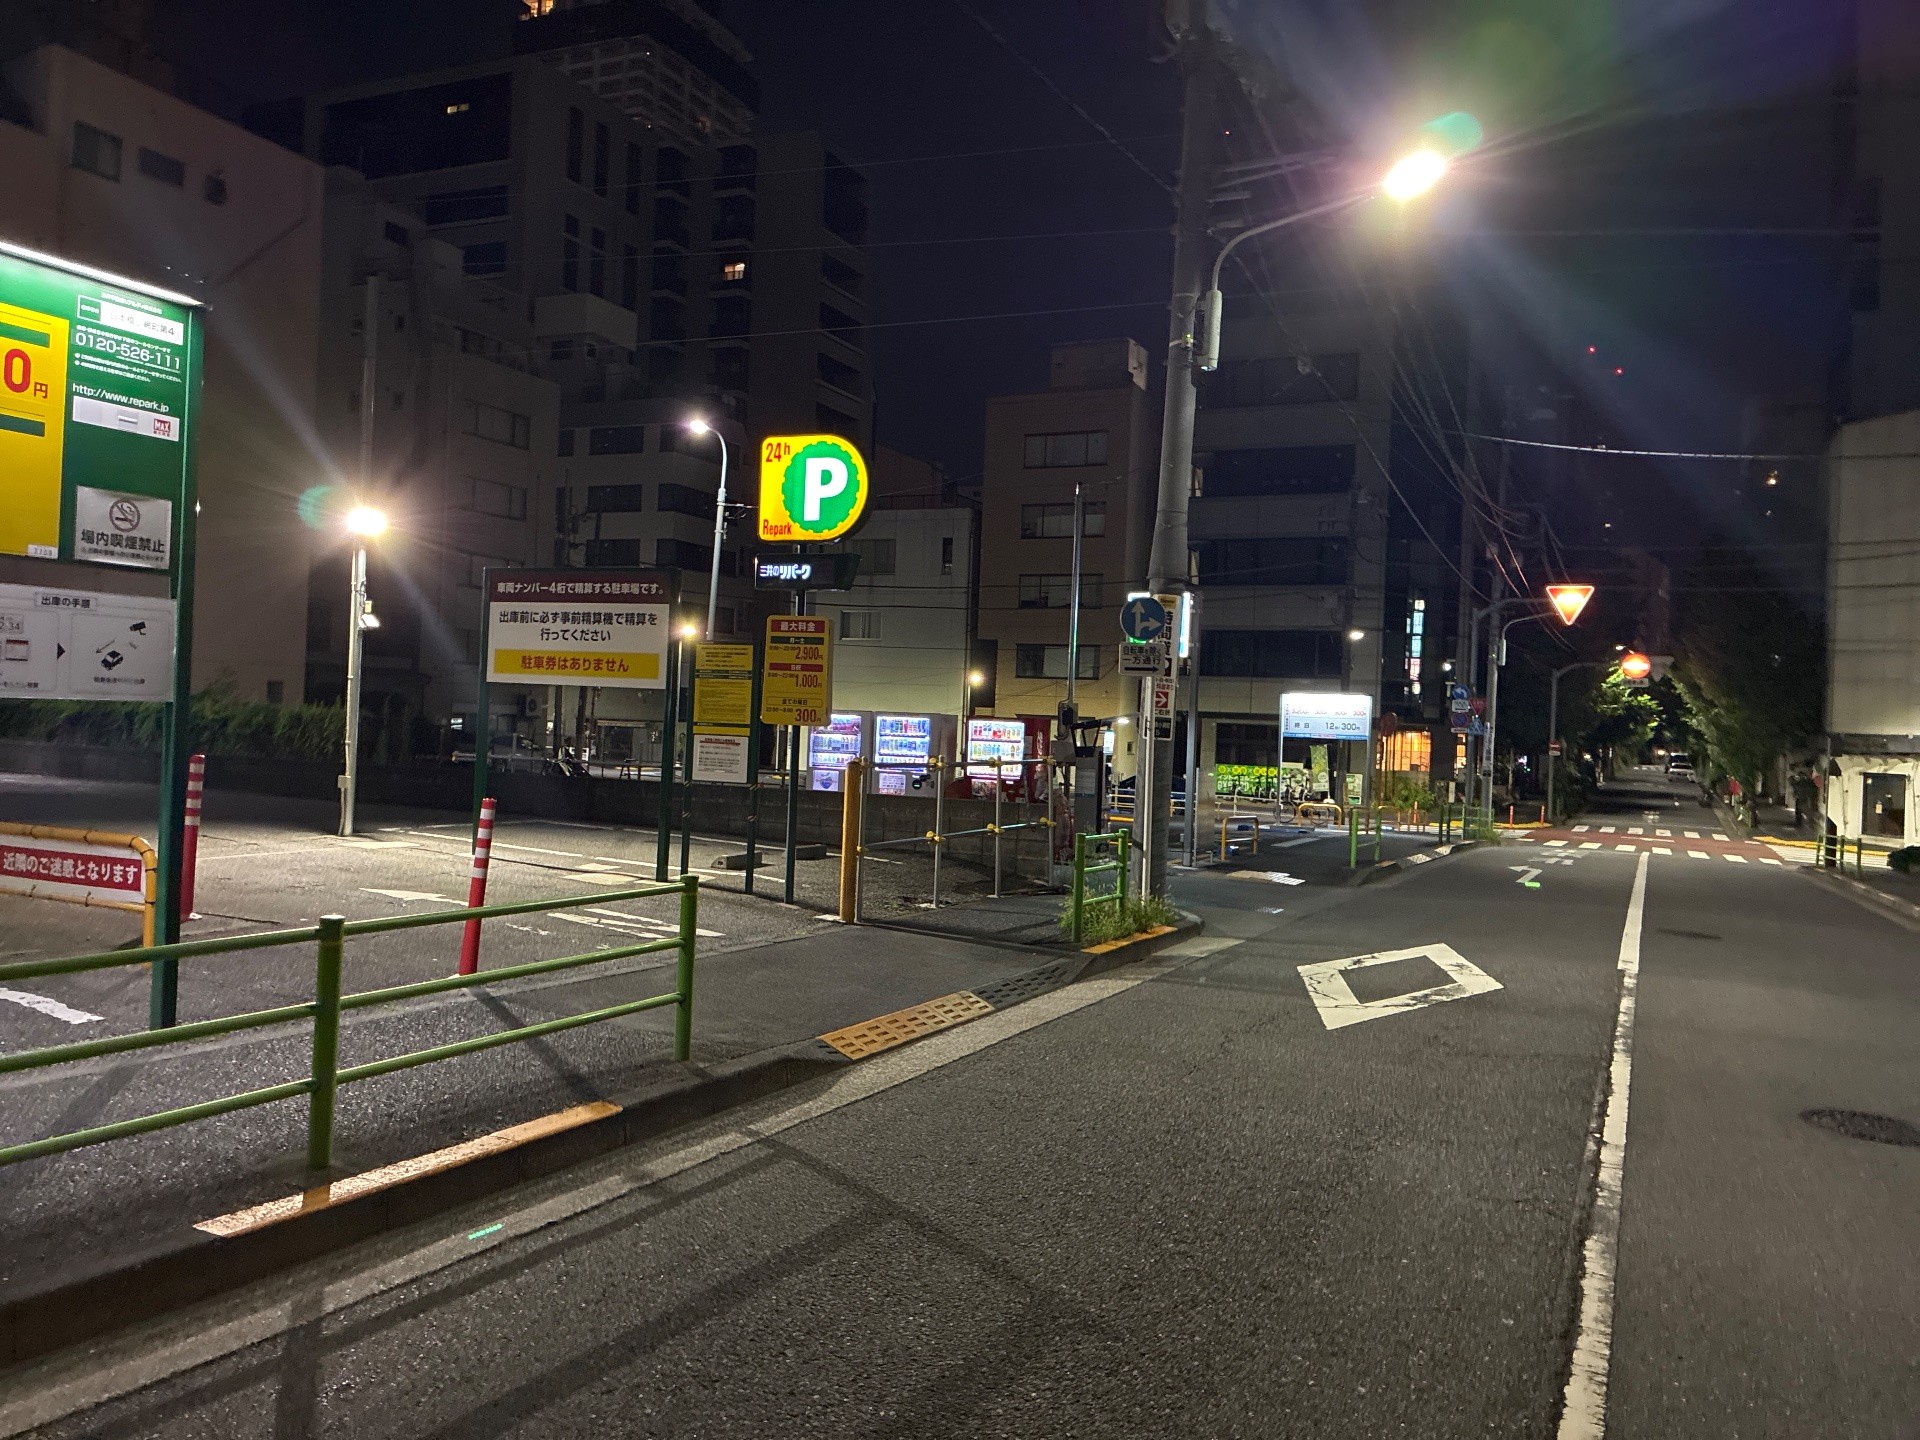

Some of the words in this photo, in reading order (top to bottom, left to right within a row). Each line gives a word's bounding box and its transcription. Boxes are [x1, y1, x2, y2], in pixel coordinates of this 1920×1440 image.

[75, 332, 180, 369] 0120-526-111
[72, 383, 170, 413] http://www.repark.jp
[154, 419, 170, 432] MAX
[765, 442, 790, 462] 24h
[804, 457, 848, 521] P
[763, 519, 792, 537] Repark
[81, 529, 165, 554] 場内喫煙禁止
[759, 563, 811, 580] 三井のリパーク
[497, 582, 664, 595] 車両ナンバー4桁で精算する駐車場です。
[41, 595, 91, 608] 出庫の手順
[499, 610, 657, 626] 出庫前に必ず事前精算機で精算を
[780, 621, 816, 632] 最大料金
[540, 628, 611, 642] 行ってください
[520, 655, 630, 673] 駐車券はありません
[1122, 656, 1162, 665] 一方通行
[795, 708, 821, 723] 300円
[3, 851, 138, 885] 近隣のご迷惑となります
